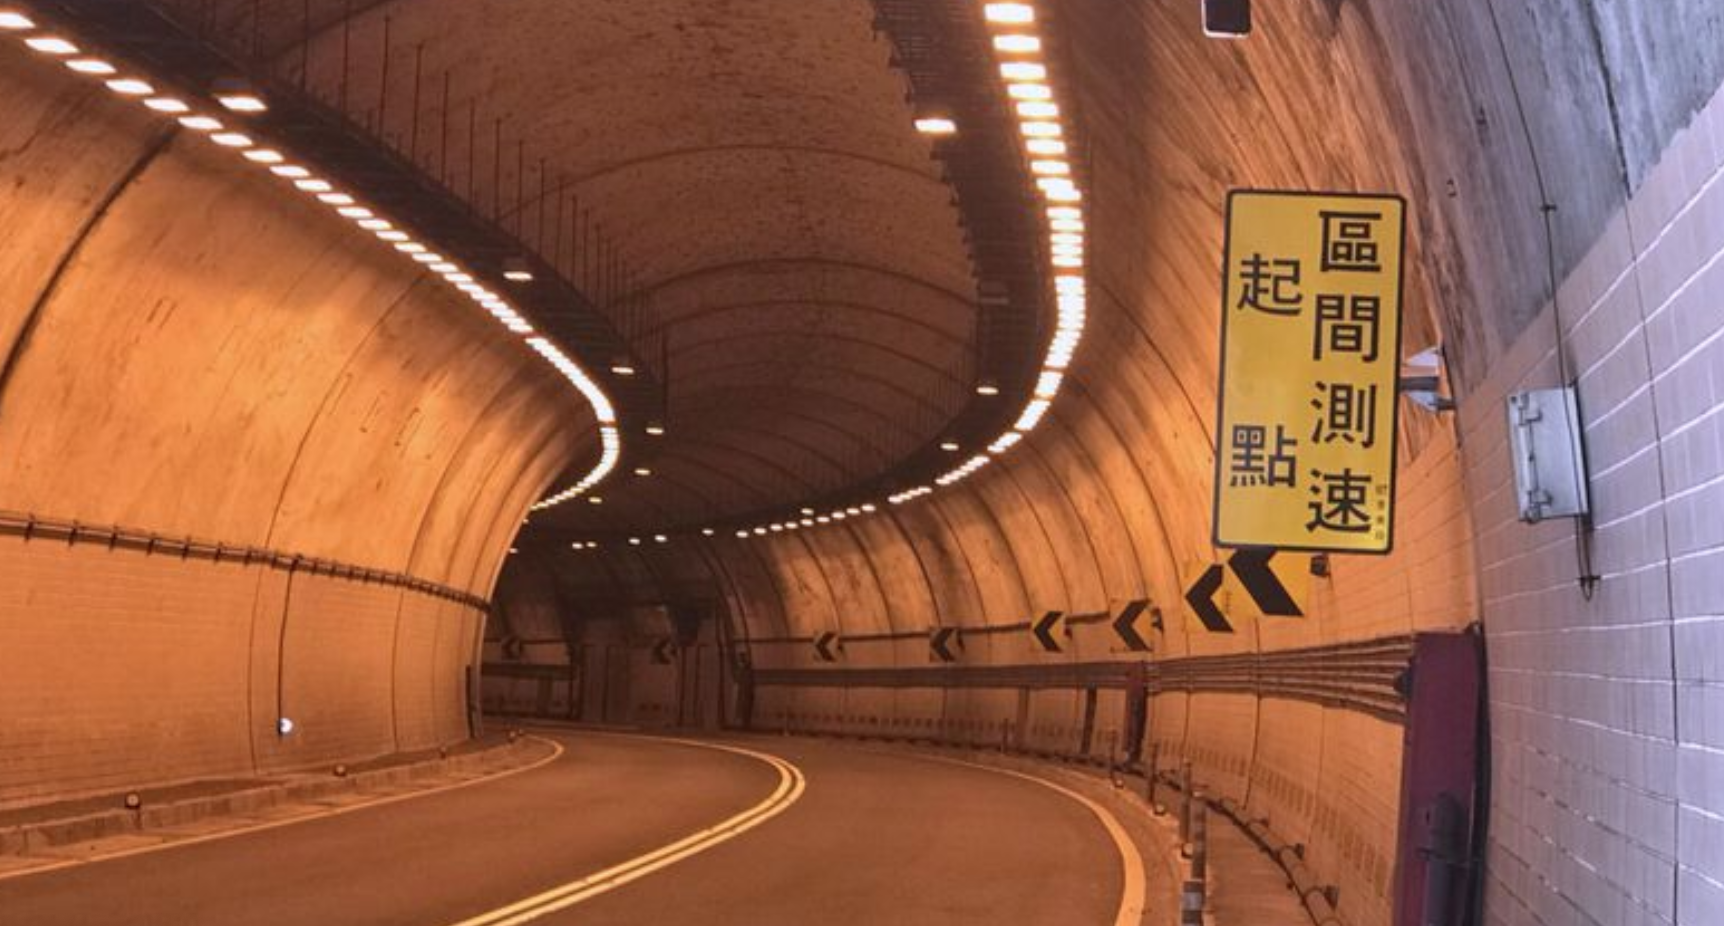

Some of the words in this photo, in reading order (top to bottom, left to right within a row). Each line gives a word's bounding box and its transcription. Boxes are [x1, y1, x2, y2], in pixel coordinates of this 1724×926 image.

[1229, 253, 1302, 489] 起點
[1306, 210, 1382, 534] 區間測速
